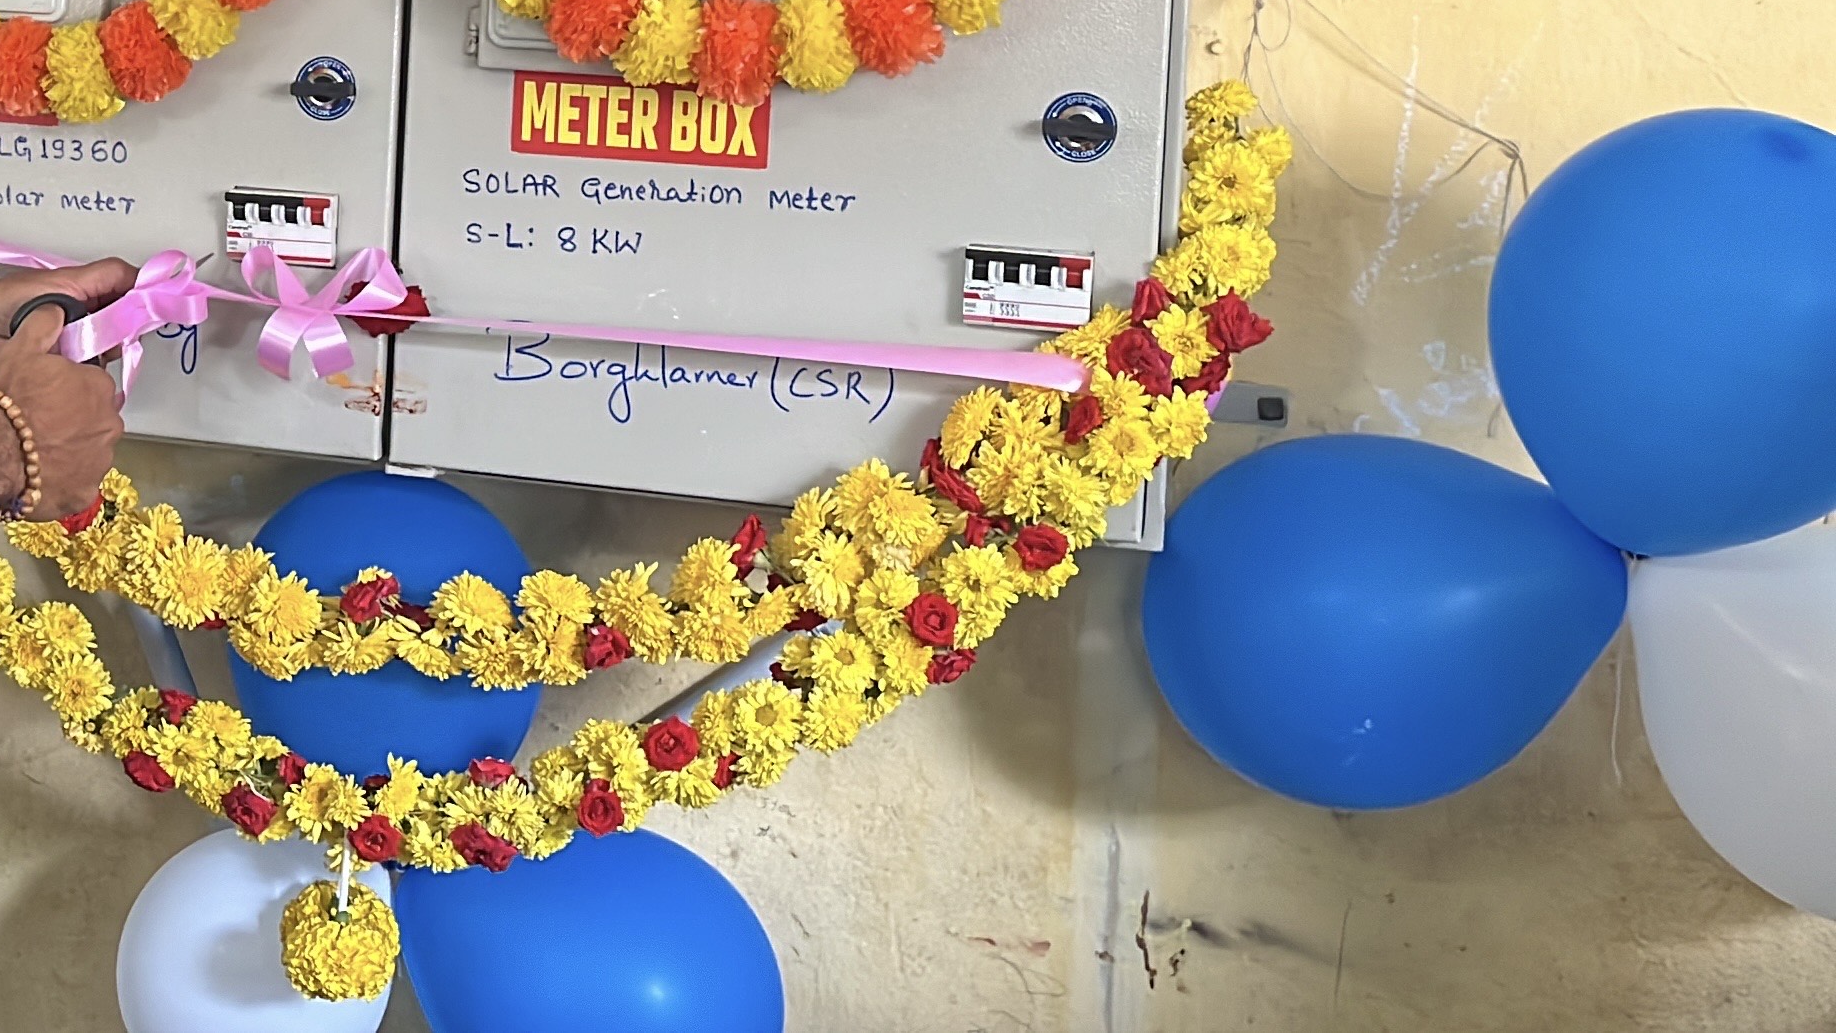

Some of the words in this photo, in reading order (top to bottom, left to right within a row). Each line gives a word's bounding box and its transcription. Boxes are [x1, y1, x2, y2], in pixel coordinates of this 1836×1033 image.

[520, 80, 659, 150] METER
[669, 89, 758, 157] BOX
[462, 168, 561, 198] SOLAR
[580, 177, 744, 206] Generation
[556, 226, 577, 253] 8
[592, 228, 643, 255] KW
